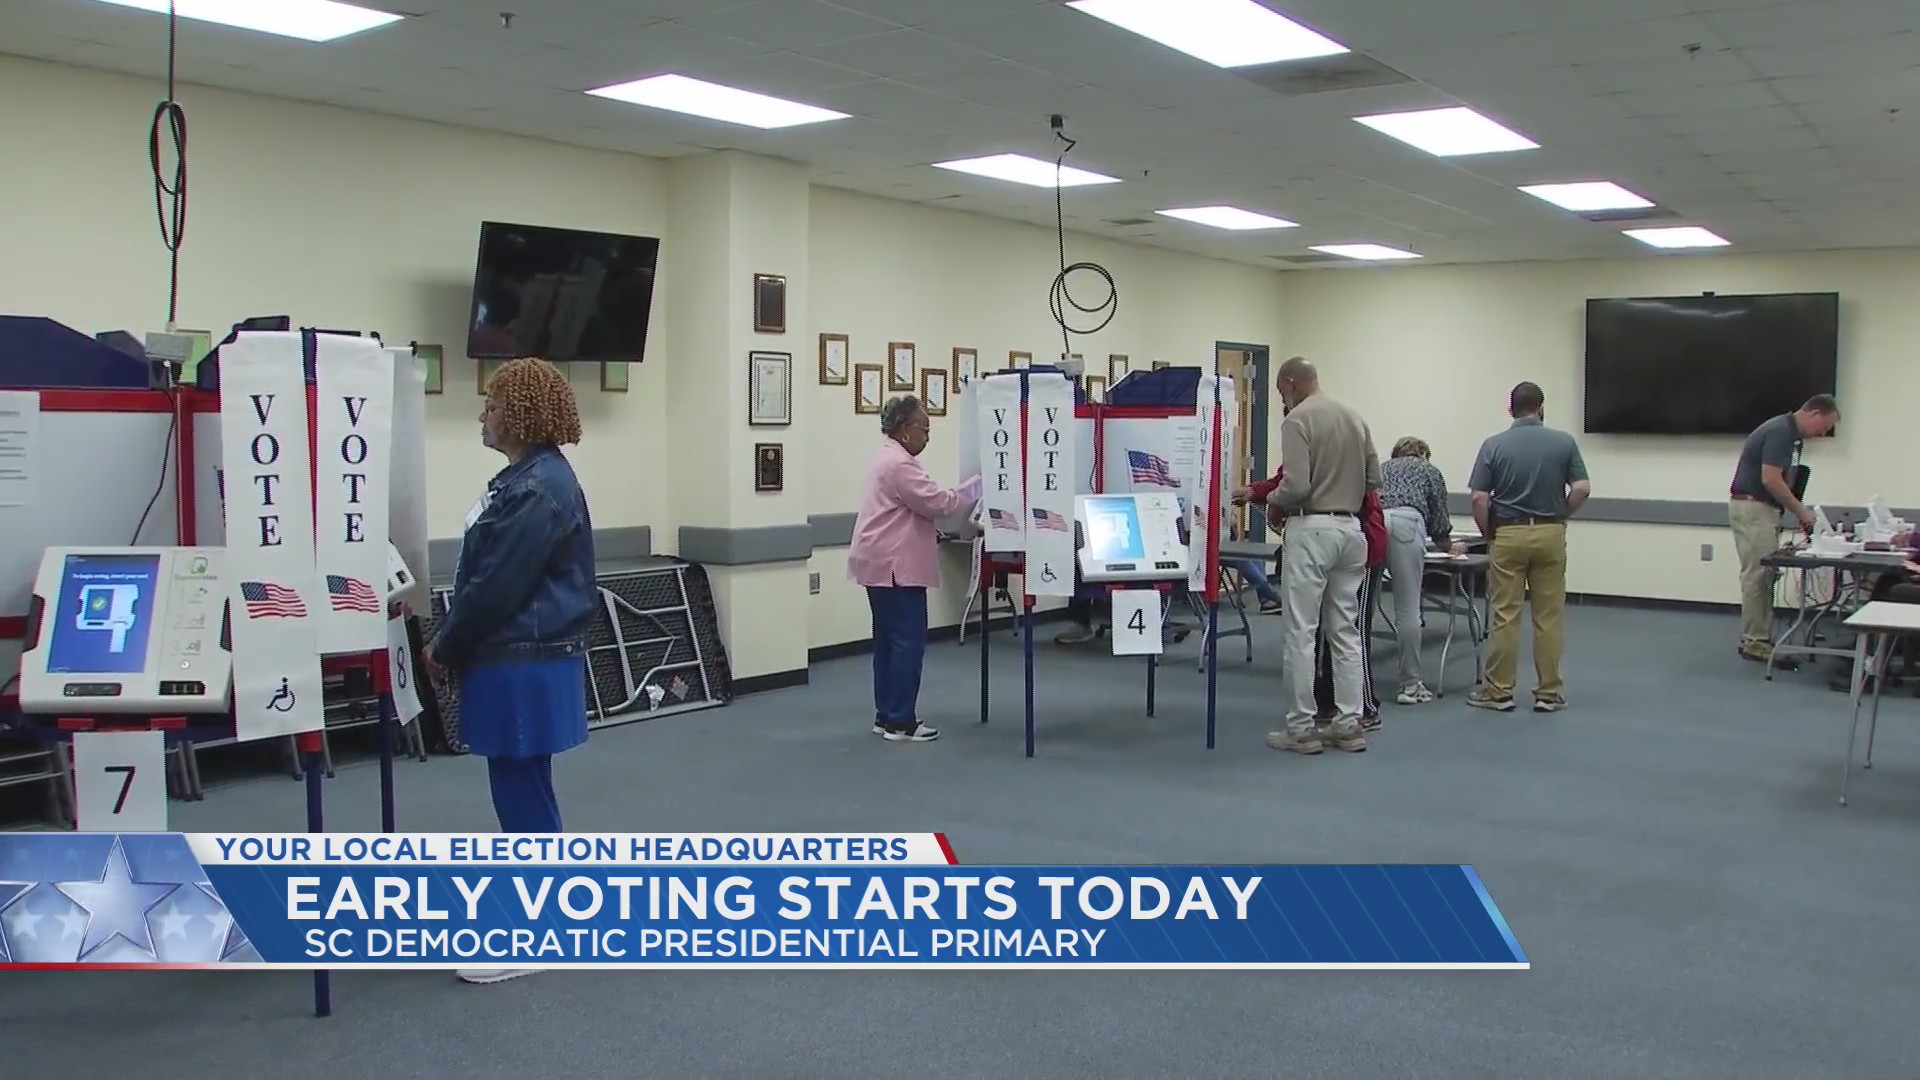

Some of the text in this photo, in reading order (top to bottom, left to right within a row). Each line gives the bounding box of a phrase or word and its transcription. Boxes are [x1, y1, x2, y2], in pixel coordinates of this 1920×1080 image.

[249, 394, 283, 547] VOTE
[340, 396, 368, 543] VOTE
[993, 407, 1009, 491] VOTE
[1043, 406, 1060, 491] VOTE
[1198, 405, 1208, 490] VOTE
[1127, 608, 1146, 635] 4
[396, 646, 407, 689] 8
[104, 765, 136, 815] 7
